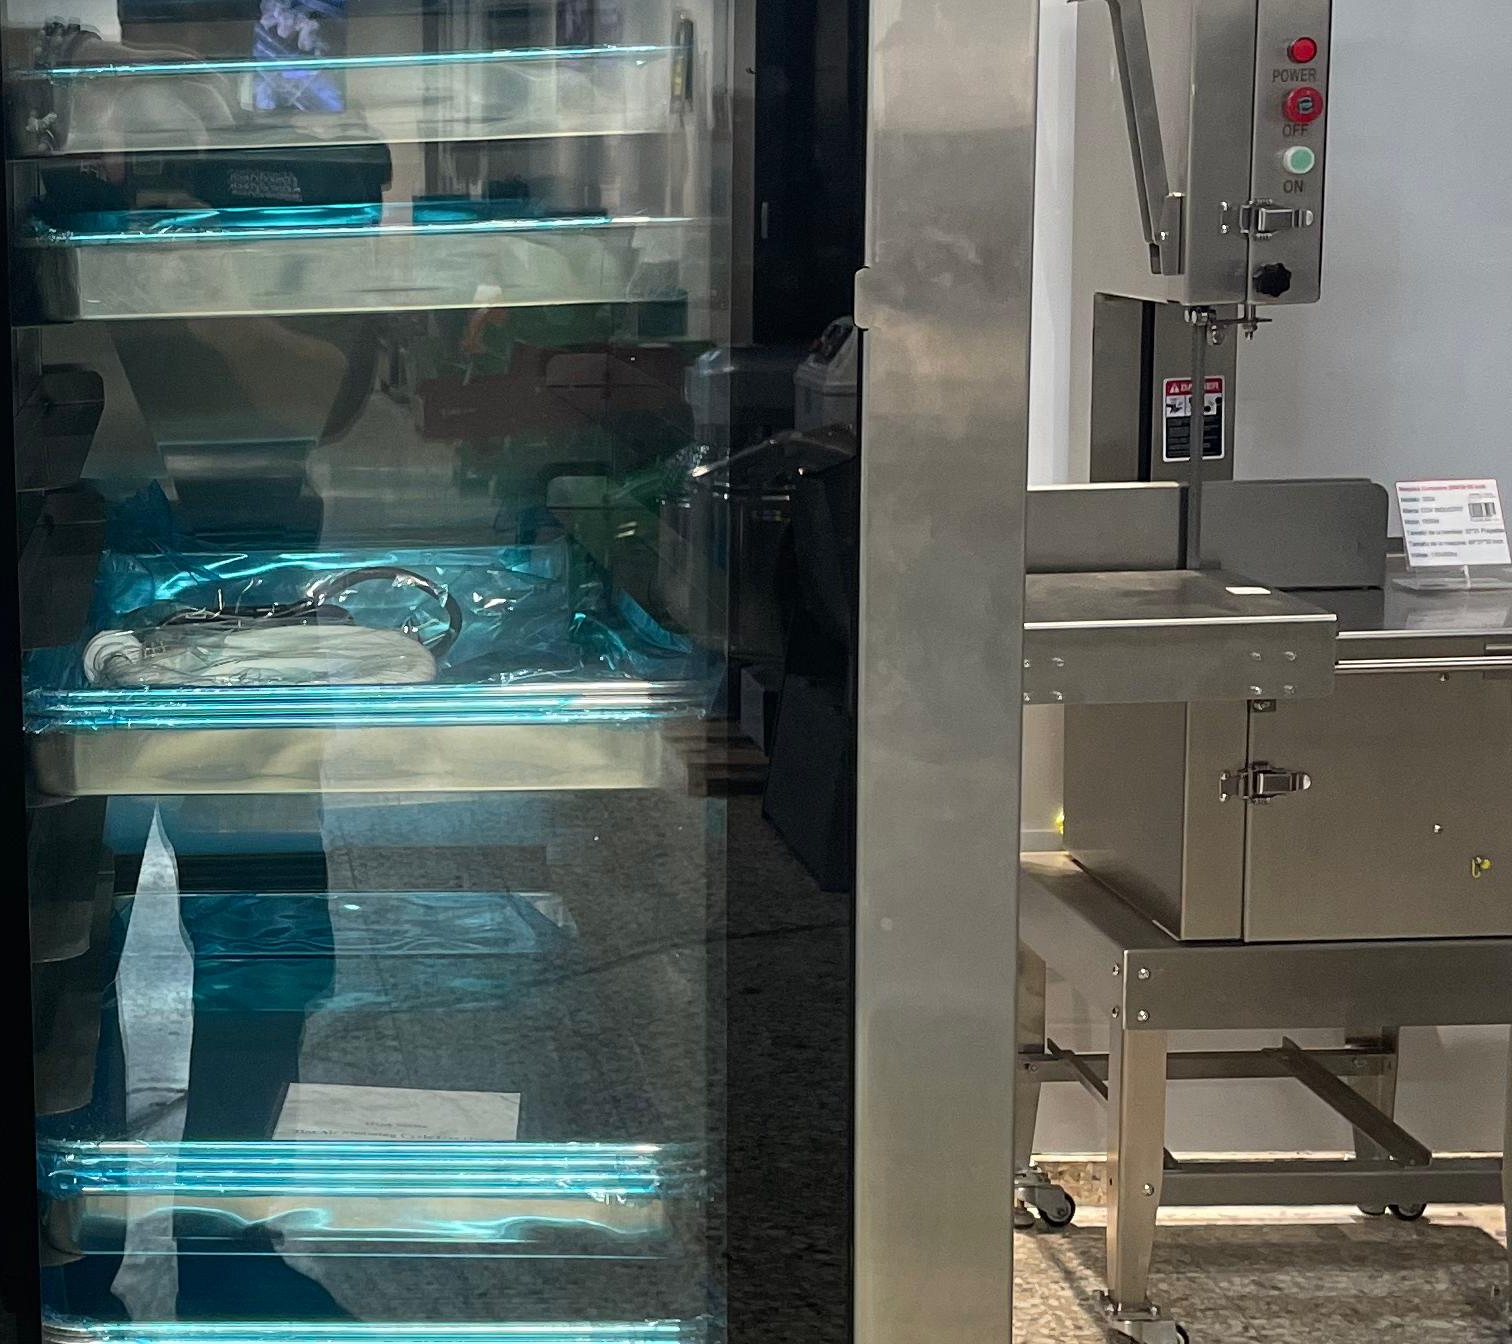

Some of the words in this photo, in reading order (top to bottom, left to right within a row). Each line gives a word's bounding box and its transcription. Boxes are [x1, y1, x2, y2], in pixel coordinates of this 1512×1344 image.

[1272, 68, 1316, 83] POWER
[1282, 124, 1310, 138] OFF
[1283, 180, 1304, 193] ON
